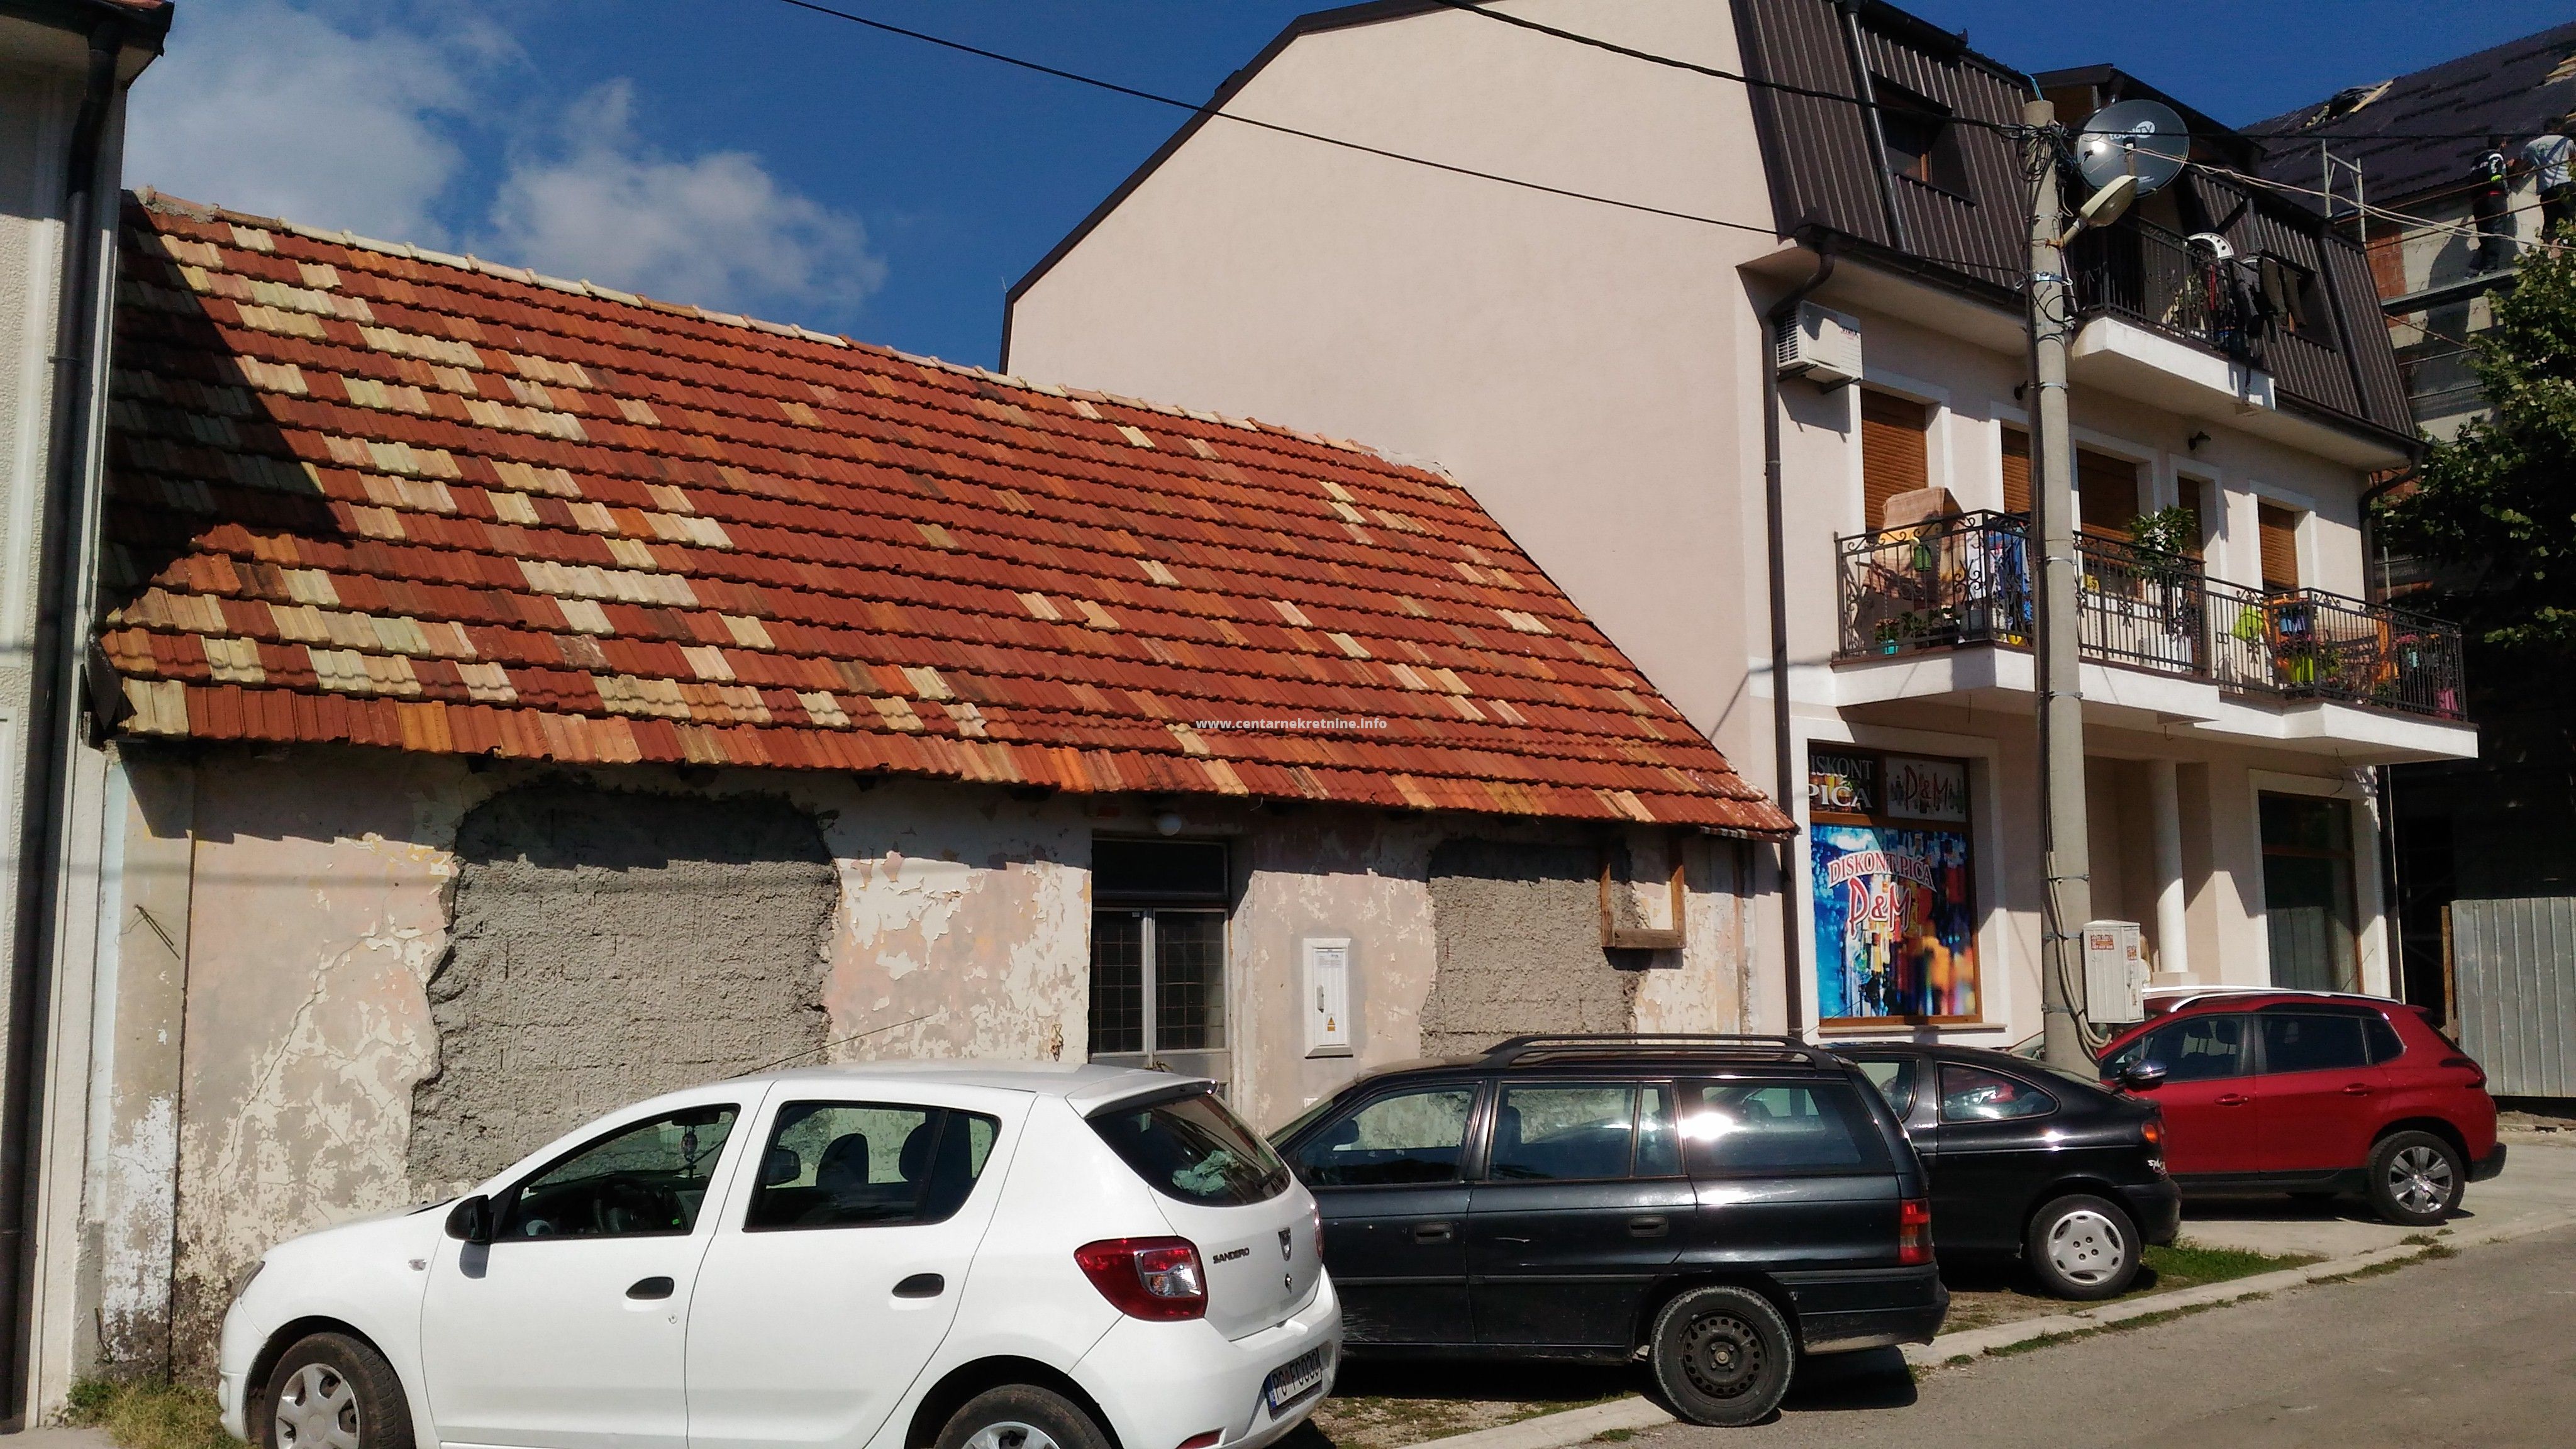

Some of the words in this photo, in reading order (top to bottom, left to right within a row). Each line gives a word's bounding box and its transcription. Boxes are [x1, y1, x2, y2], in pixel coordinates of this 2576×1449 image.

[1810, 755, 1874, 780] ISKONT
[1830, 852, 1896, 884] DISKONT
[1901, 857, 1934, 887] PIĆA
[1849, 877, 1911, 936] P&M
[1213, 1247, 1250, 1264] SANDERO
